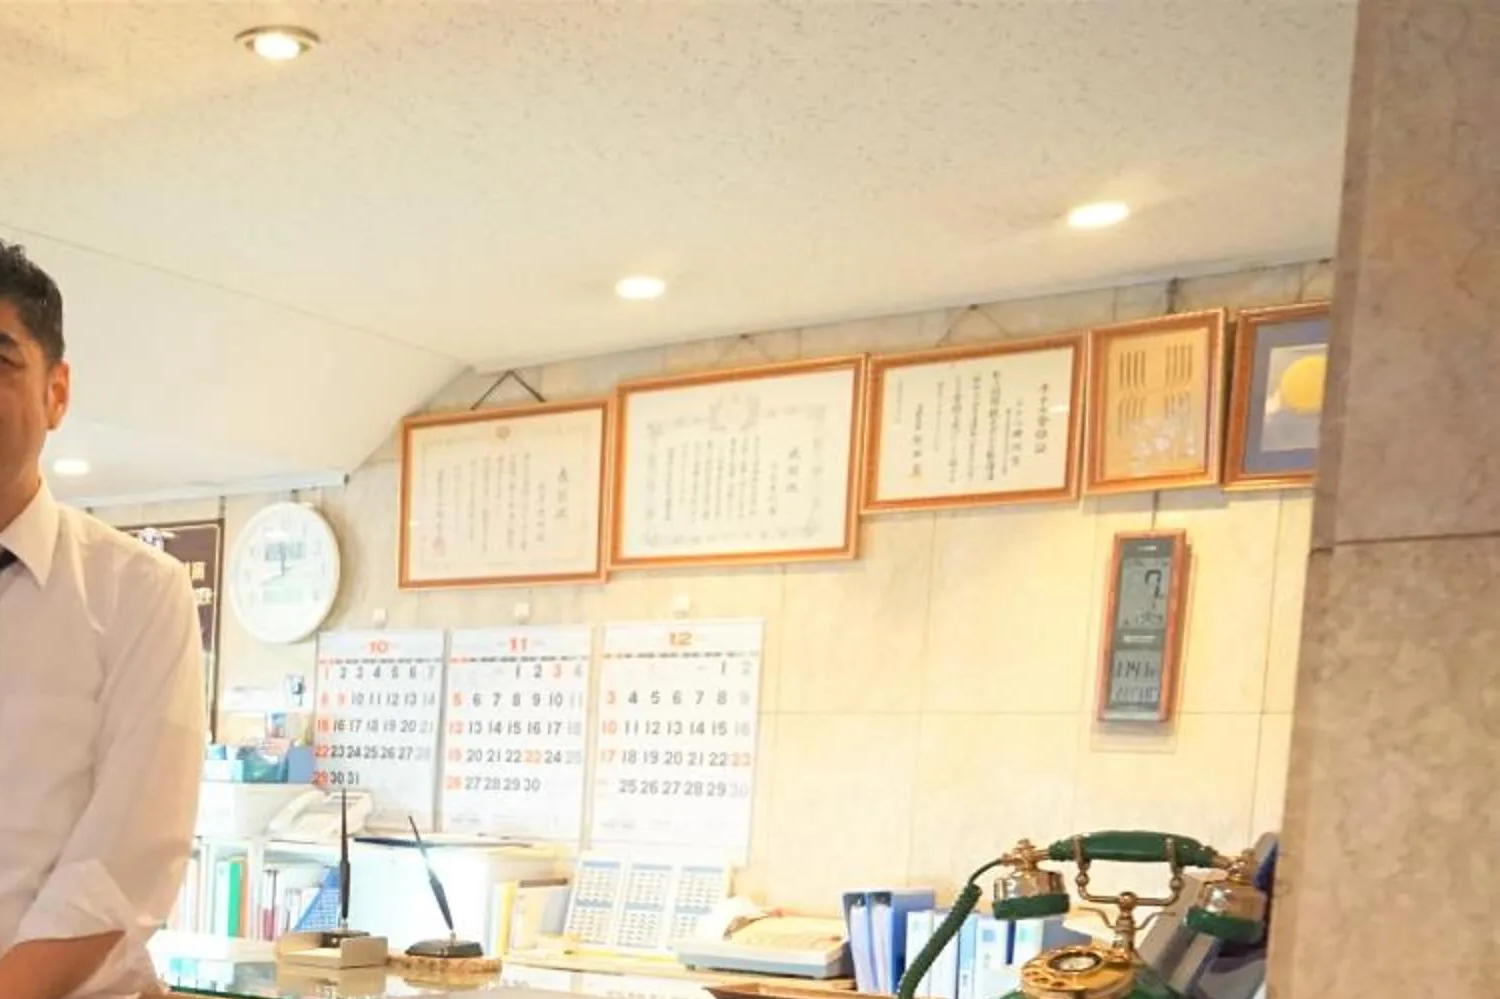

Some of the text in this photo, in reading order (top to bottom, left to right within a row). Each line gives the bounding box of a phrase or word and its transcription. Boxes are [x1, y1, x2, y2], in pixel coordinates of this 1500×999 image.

[510, 638, 528, 651] 11
[669, 632, 693, 646] 12
[370, 641, 389, 653] 10
[340, 666, 347, 679] 2
[373, 666, 381, 679] 4
[515, 663, 520, 679] 1
[534, 663, 542, 679] 2
[720, 660, 727, 675] 1
[352, 692, 364, 705] 10
[369, 692, 381, 705] 11
[386, 692, 399, 705] 12
[404, 692, 417, 705] 13
[473, 692, 482, 707] 6
[493, 692, 502, 707] 7
[512, 692, 521, 707] 8
[532, 692, 541, 707] 9
[549, 692, 563, 707] 10
[627, 690, 638, 705] 4
[650, 690, 661, 705] 5
[672, 690, 682, 705] 6
[695, 690, 705, 705] 7
[716, 690, 727, 705] 8
[333, 719, 345, 732] 16
[349, 719, 362, 732] 17
[400, 719, 416, 732] 20
[468, 721, 482, 735] 13
[488, 721, 502, 735] 14
[507, 721, 521, 735] 15
[527, 721, 541, 735] 16
[547, 721, 562, 735] 17
[624, 720, 639, 735] 11
[645, 720, 661, 735] 12
[667, 720, 683, 735] 13
[689, 720, 705, 735] 14
[711, 720, 728, 735] 15
[331, 745, 345, 759] 23
[347, 745, 361, 759] 24
[364, 745, 378, 759] 25
[380, 745, 395, 759] 26
[398, 746, 414, 760] 27
[466, 749, 483, 763] 20
[486, 749, 501, 763] 21
[505, 749, 522, 763] 22
[544, 750, 562, 764] 24
[621, 750, 637, 764] 18
[642, 750, 659, 765] 19
[663, 751, 683, 766] 20
[688, 751, 704, 767] 21
[708, 752, 728, 767] 22
[330, 771, 345, 784] 30
[347, 771, 359, 784] 31
[465, 776, 482, 791] 27
[483, 776, 501, 791] 28
[503, 776, 521, 791] 29
[522, 777, 542, 792] 30
[619, 779, 637, 794] 25
[640, 780, 659, 795] 26
[662, 780, 682, 796] 27
[684, 781, 703, 796] 28
[707, 781, 727, 797] 29
